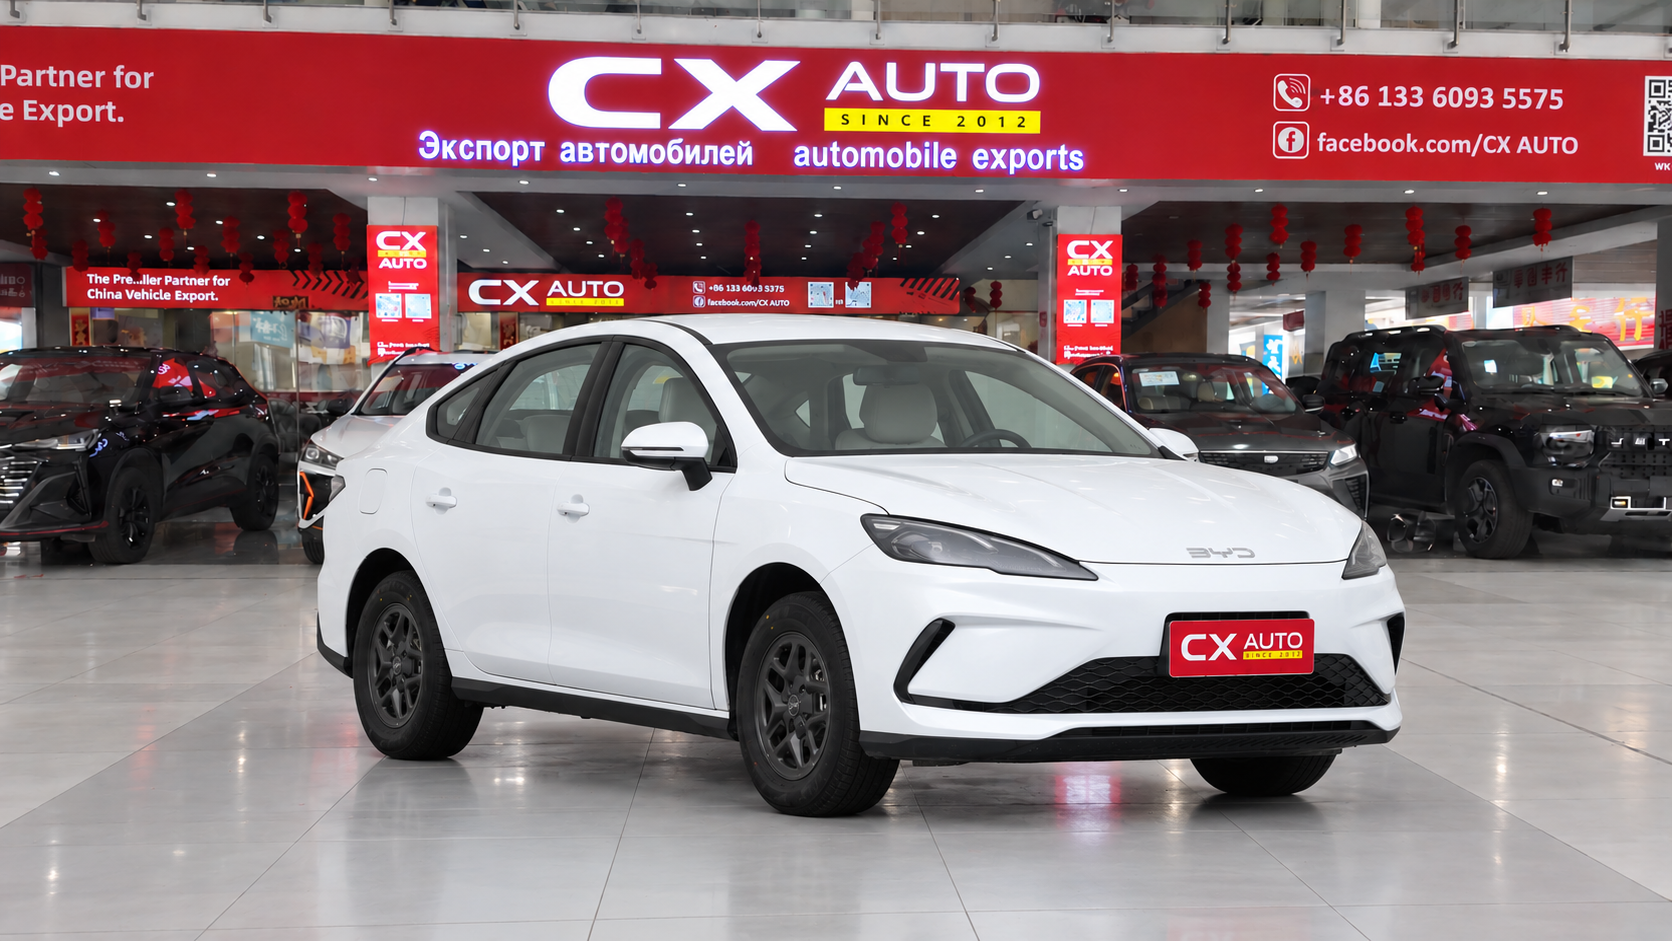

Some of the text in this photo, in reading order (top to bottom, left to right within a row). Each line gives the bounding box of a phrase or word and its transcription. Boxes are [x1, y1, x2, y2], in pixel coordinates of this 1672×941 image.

[1, 65, 154, 88] Partner for
[548, 57, 1040, 131] CX AUTO
[1321, 86, 1563, 109] +86 133 6093 5575
[24, 100, 123, 127] Export.
[842, 114, 1025, 127] SINCE 2012
[418, 130, 752, 166] Экспорт автомобилей
[1317, 133, 1578, 156] facebook.com/CX AUTO
[794, 141, 1083, 174] automobile exports
[376, 231, 427, 250] CX
[1067, 240, 1113, 259] CX
[378, 258, 427, 269] AUTO
[1067, 265, 1113, 276] AUTO
[87, 274, 109, 284] The
[165, 276, 210, 286] Partner
[213, 275, 230, 286] for
[725, 284, 741, 293] 133
[87, 288, 218, 303] China Vehicle Export.
[469, 280, 624, 305] CX AUTO
[769, 299, 790, 308] AUTO
[1186, 547, 1256, 559] BYD
[1181, 632, 1303, 661] CX AUTO
